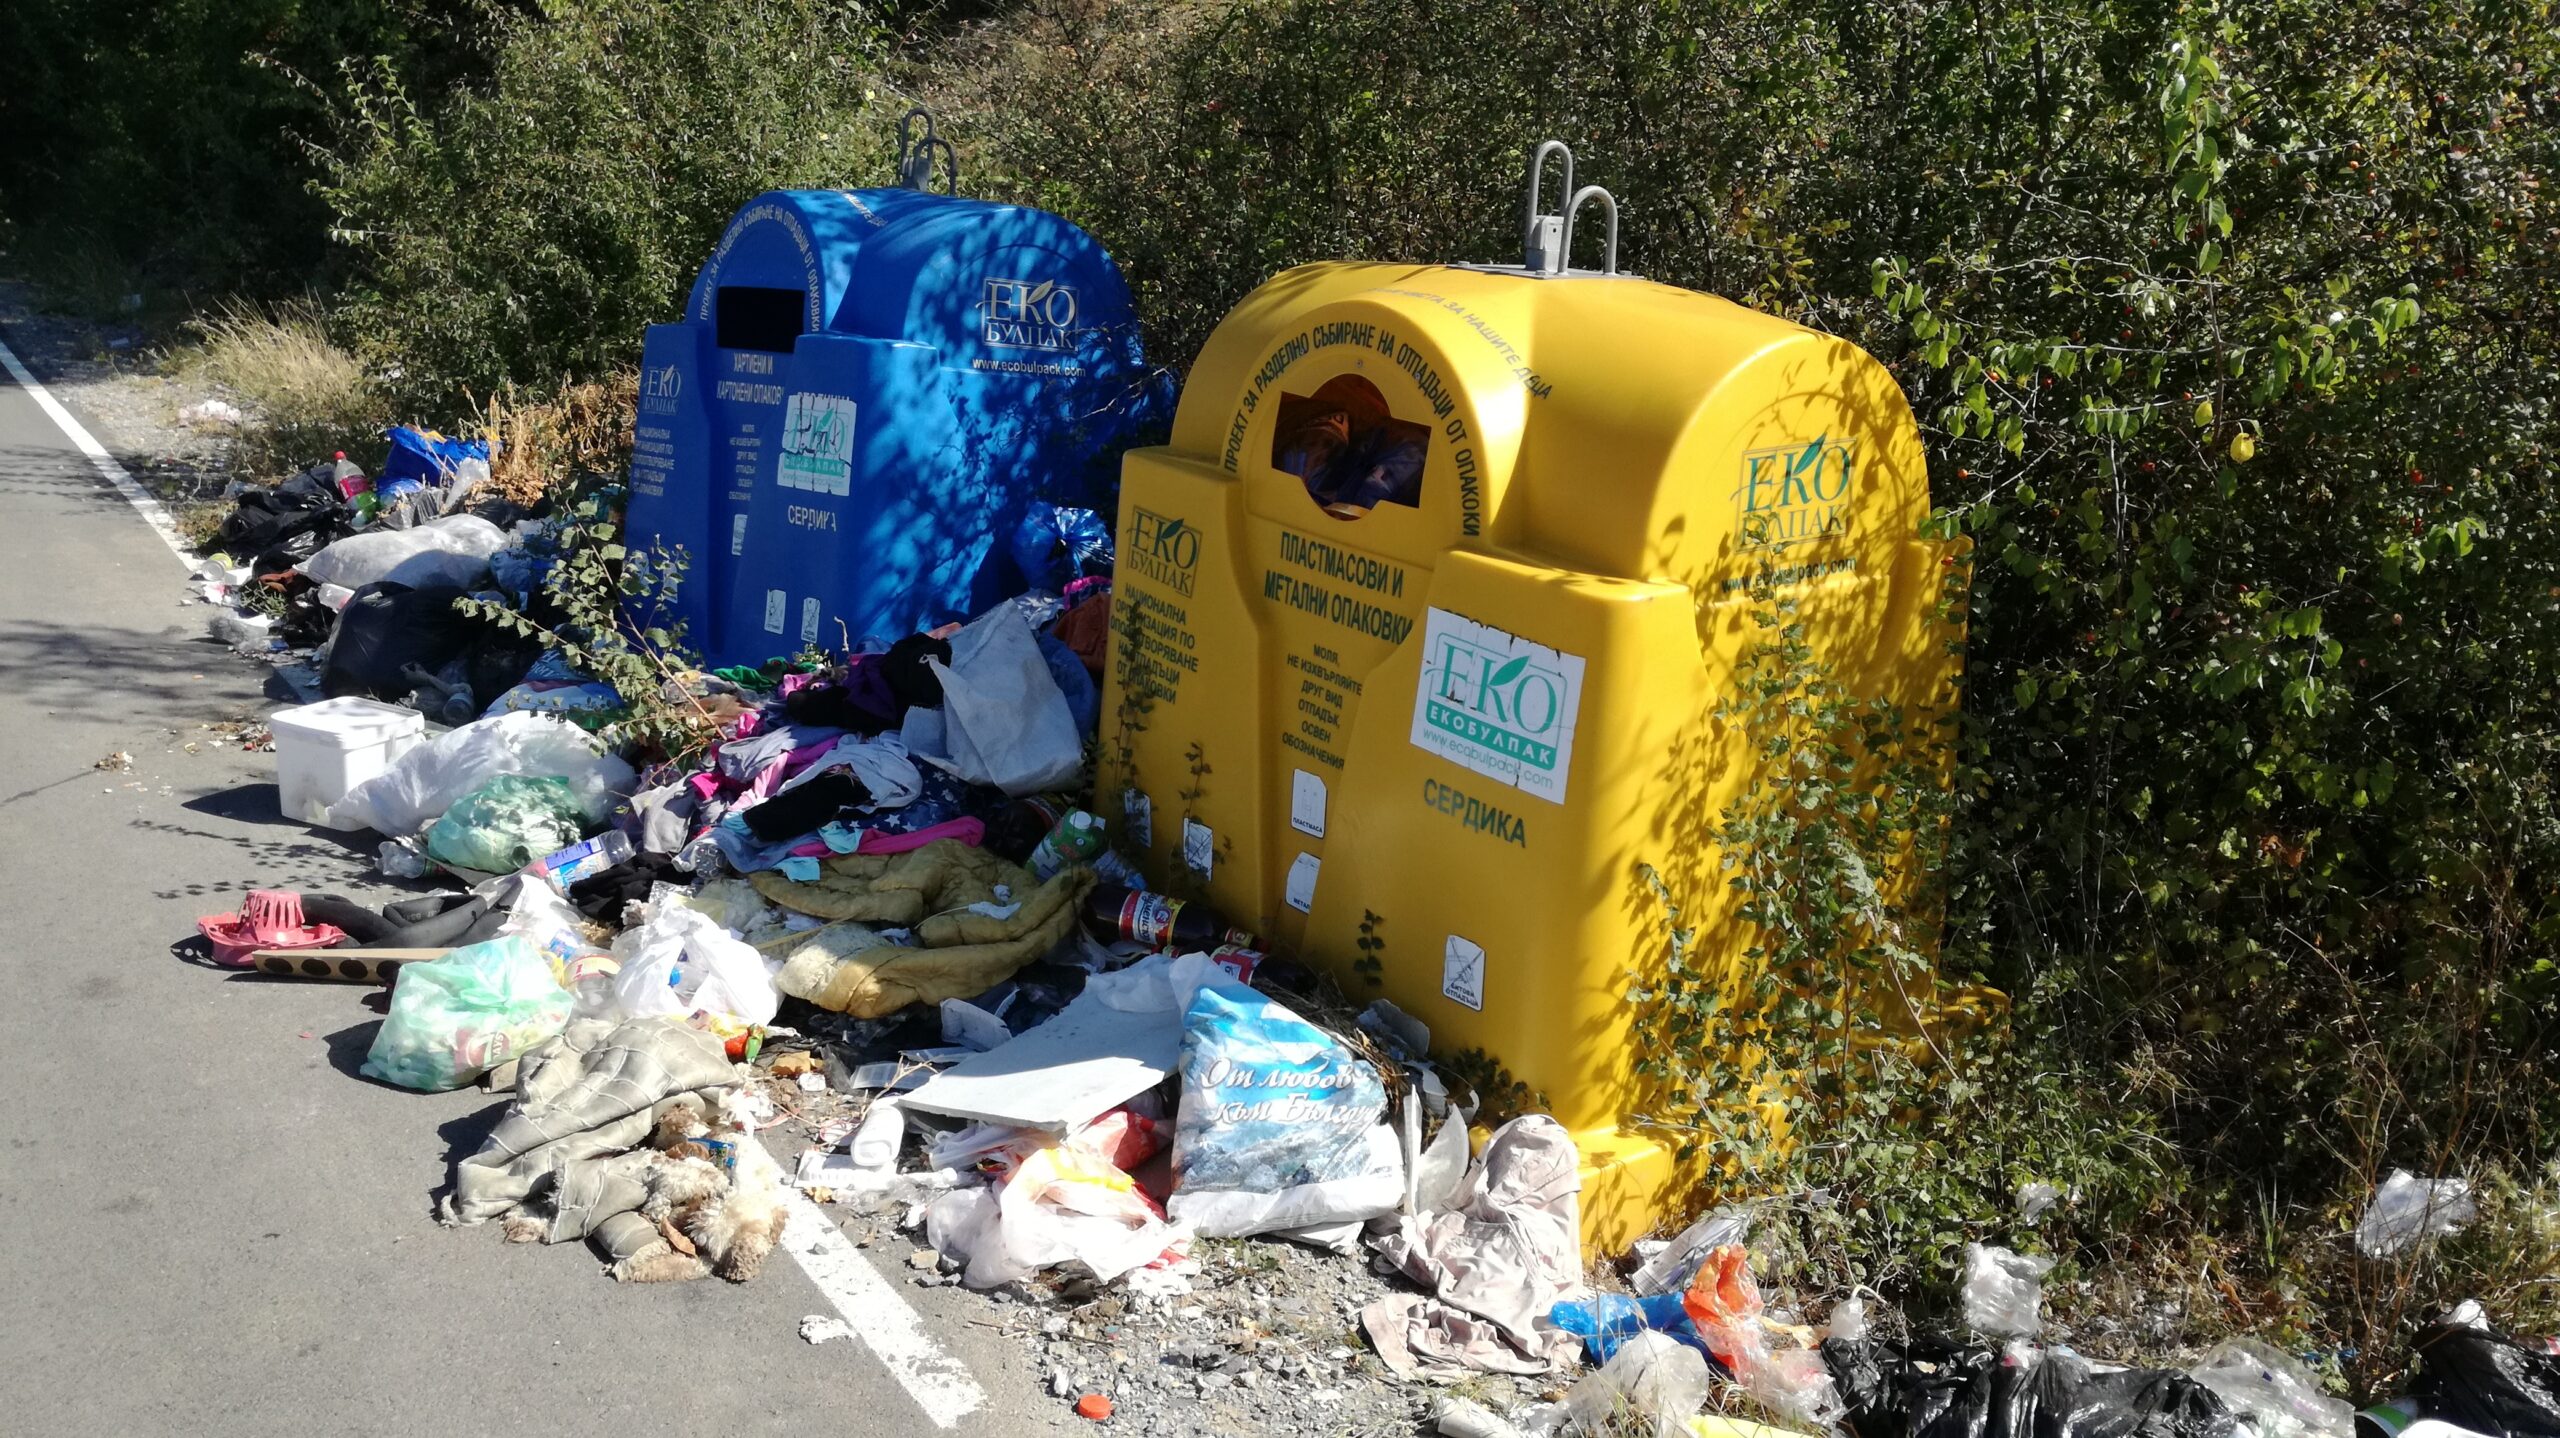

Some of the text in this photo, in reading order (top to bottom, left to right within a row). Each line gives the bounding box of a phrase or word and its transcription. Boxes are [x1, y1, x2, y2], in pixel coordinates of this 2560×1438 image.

[1462, 313, 1521, 366] НАШИТЕ
[1512, 367, 1553, 400] ДЕЦА
[1224, 321, 1481, 537] ПРОЕКТ ЗА РАЗДЕЛНО СЪБИРАНЕ НА ОТПАДЪЦИ ОТ ОПАКОКИ
[1129, 551, 1193, 595] БУЛПАК
[1280, 531, 1404, 599] ПЛАСТМАСОВИ И
[1125, 583, 1187, 626] НАЦИОНАЛНА
[1264, 569, 1329, 620] МЕТАЛНИ
[1110, 615, 1199, 673] ОПОТВОРЯВАНЕ
[1115, 598, 1196, 650] ОРГНИЗАЦИЯ ПО
[1131, 648, 1181, 687] ТПАДЪЦИ
[1287, 653, 1363, 697] НЕ ИЗХВЪРЛЯЙТЕ
[1301, 679, 1343, 710] ДРУГ ВИД
[1282, 731, 1345, 771] ОБОЗНАЧЕНИЯ
[1301, 720, 1332, 744] ОСВЕН
[1429, 705, 1553, 766] ЕКОБУЛПАК
[1292, 817, 1323, 833] ПЛАСТМАСА
[1424, 777, 1527, 849] СЕРДИКА
[1200, 1056, 1253, 1090] От
[1212, 1102, 1272, 1125] към
